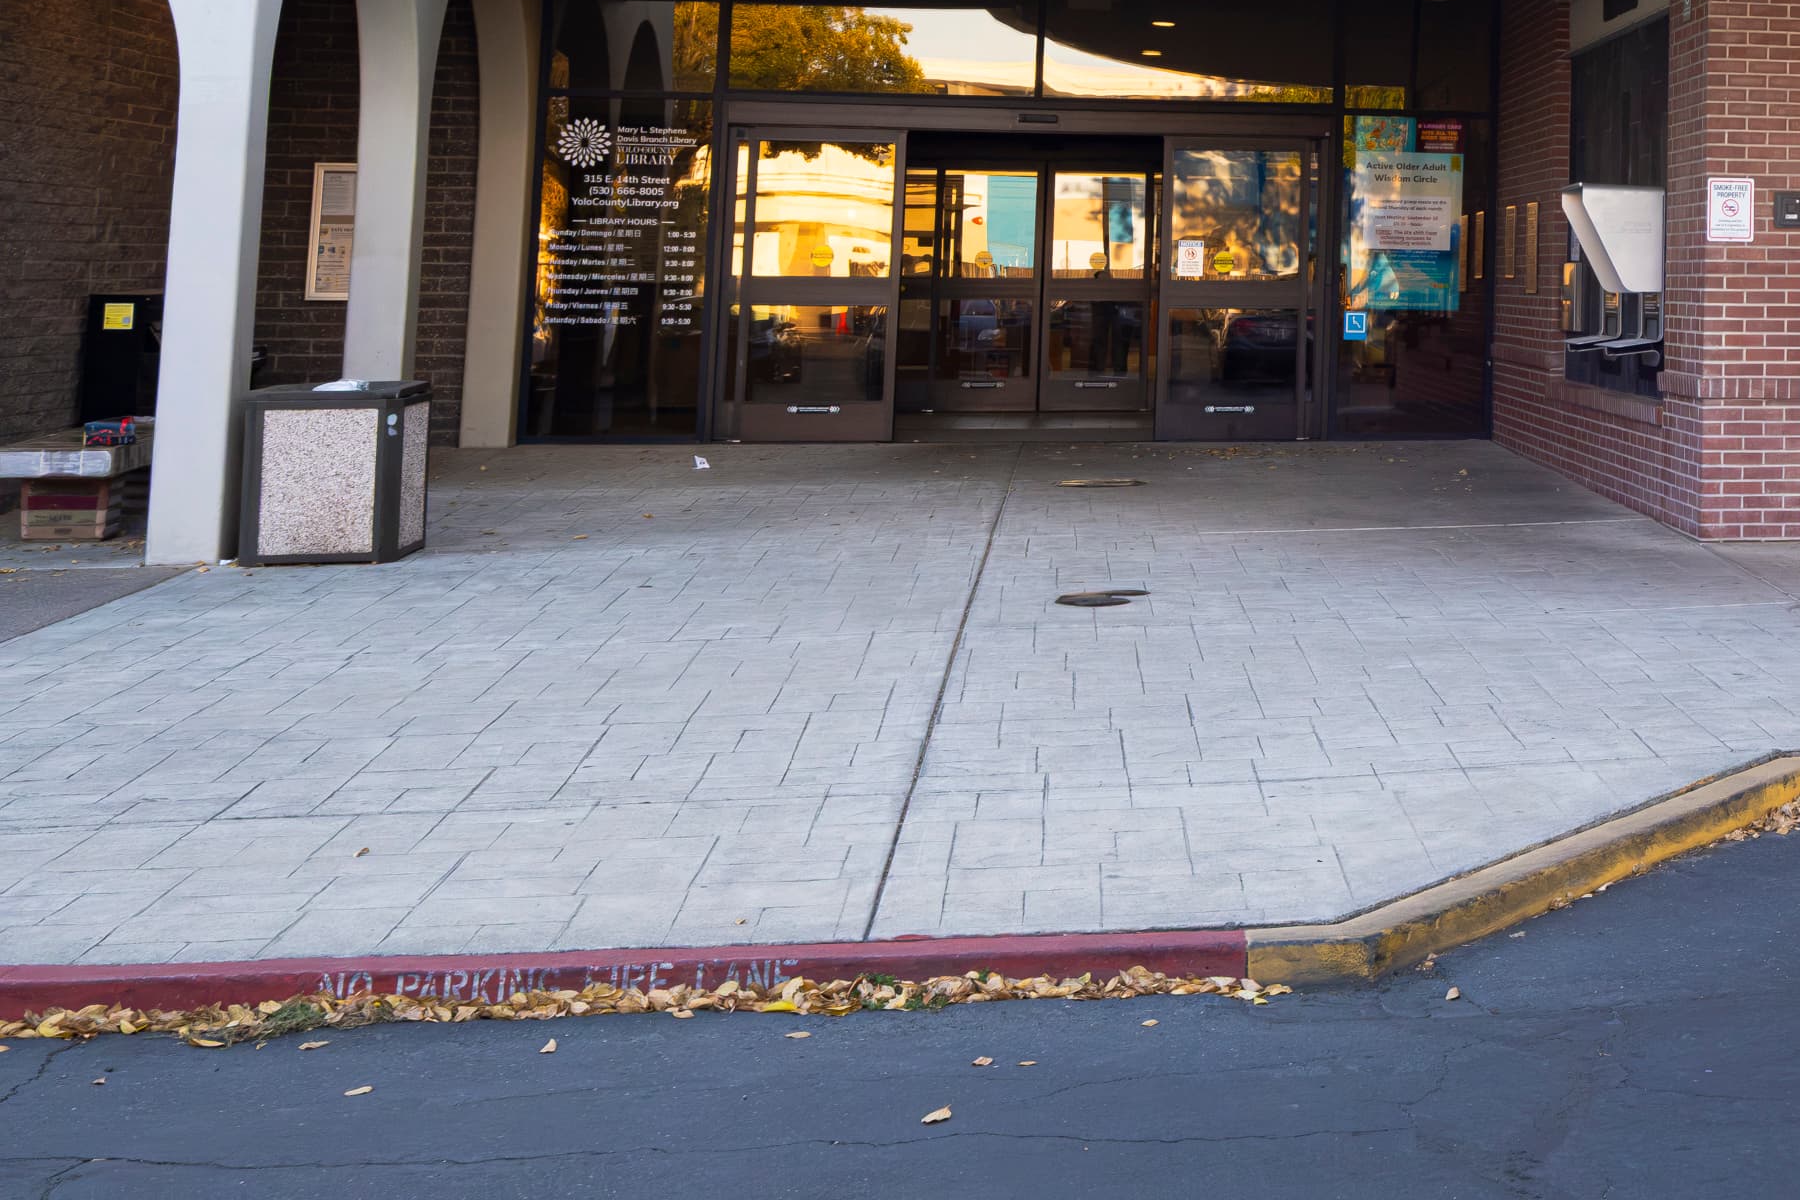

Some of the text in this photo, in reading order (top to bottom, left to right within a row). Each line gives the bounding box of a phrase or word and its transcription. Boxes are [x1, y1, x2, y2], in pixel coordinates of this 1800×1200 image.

[618, 126, 638, 135] Mary
[649, 126, 687, 135] Stephens
[669, 136, 697, 145] Library
[641, 146, 678, 154] COUNTY
[616, 154, 677, 166] LIBRARY
[1366, 161, 1447, 171] Active Older Adult
[584, 174, 603, 183] 315
[616, 175, 639, 184] 14th
[640, 176, 670, 184] Street
[1413, 175, 1438, 183] Circle
[589, 187, 614, 196] (530)
[571, 197, 680, 210] YoloCountyLibrary.org
[549, 244, 577, 252] Monday
[545, 302, 568, 310] Friday
[545, 316, 576, 325] Saturday
[320, 971, 373, 1000] NO
